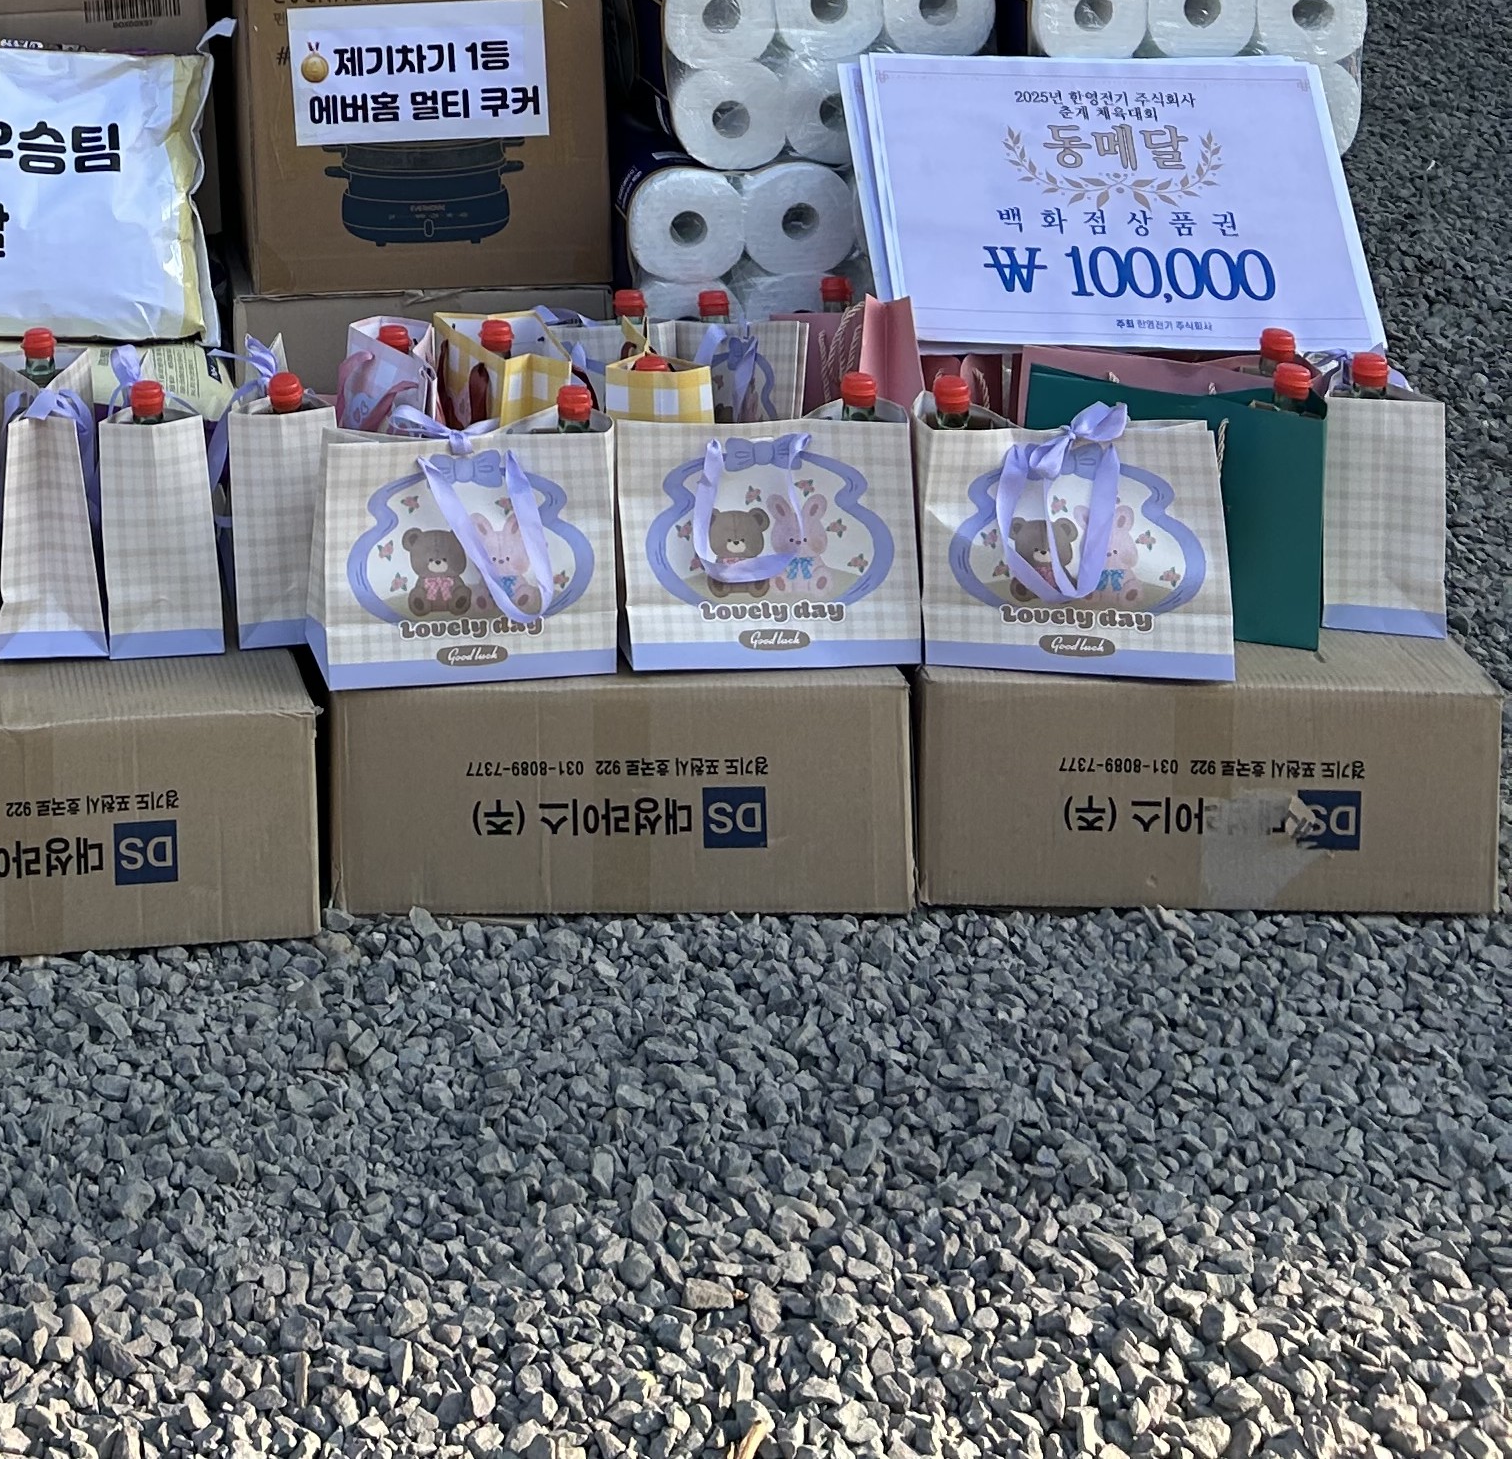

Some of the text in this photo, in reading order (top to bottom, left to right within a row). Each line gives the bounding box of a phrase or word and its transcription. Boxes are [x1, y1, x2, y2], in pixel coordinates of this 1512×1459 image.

[333, 40, 510, 79] 제기차기 1등
[308, 85, 541, 126] 에버홈 멀티 쿠커
[1014, 89, 1196, 109] 2025년 한영전기 주식회사
[1096, 106, 1158, 122] 체육대회
[1043, 123, 1189, 171] 동메달
[1064, 245, 1277, 304] 100,000
[699, 600, 846, 624] Lovely day
[1000, 604, 1155, 631] Lovely day
[399, 615, 489, 640] Lovely
[749, 629, 801, 649] Good luck
[446, 644, 499, 666] Good luck
[1050, 635, 1105, 655] Good luck
[465, 755, 769, 778] 경기도 포천시 호국로 922 031-8089-7377
[1058, 756, 1366, 780] 경기도 포천시 호국로 922 031-8089-7377
[5, 801, 32, 818] 922
[36, 797, 81, 817] 호국로
[85, 794, 131, 815] 포천시
[134, 789, 180, 811] 경기도
[472, 797, 763, 837] DS 대성라이스 (주)
[1063, 795, 1118, 834] (주)
[118, 835, 173, 870] DS
